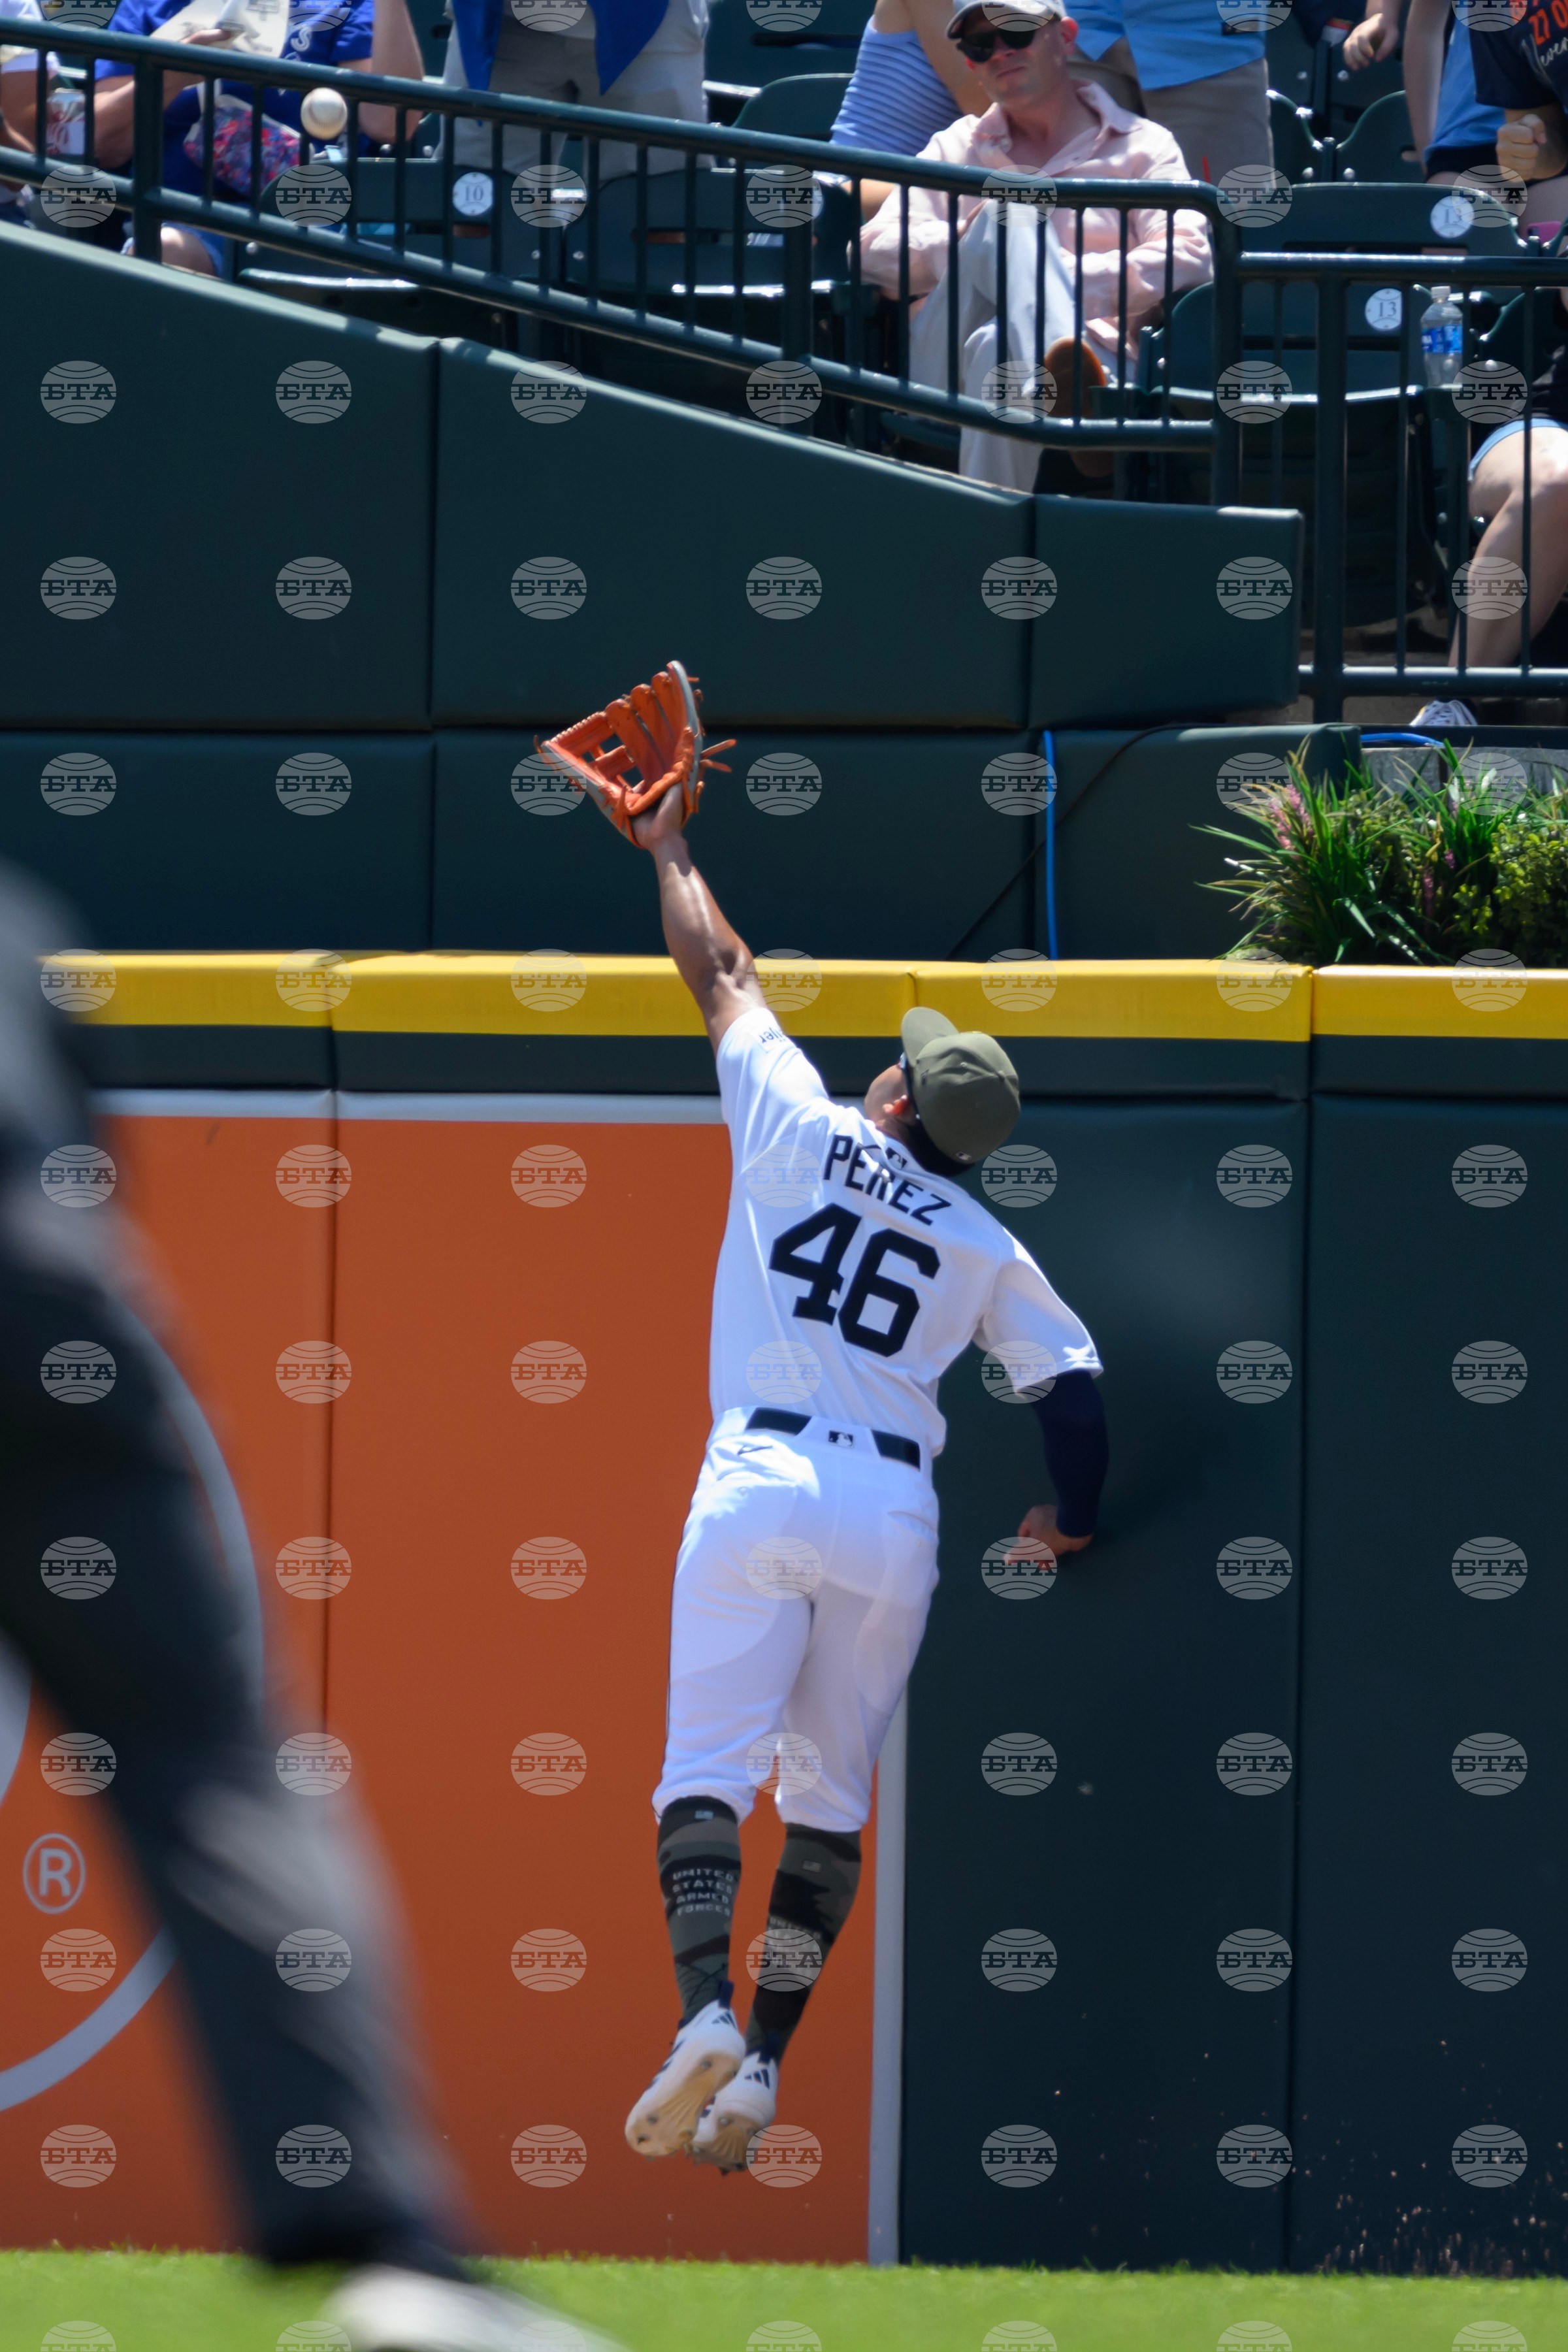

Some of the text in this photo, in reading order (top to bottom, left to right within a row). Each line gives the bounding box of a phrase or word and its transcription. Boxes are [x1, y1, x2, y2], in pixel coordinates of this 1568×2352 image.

[465, 185, 484, 201] 10
[1444, 208, 1462, 225] 13
[1378, 301, 1397, 318] 13
[823, 1135, 951, 1226] PEREZ
[769, 1203, 940, 1358] 46
[672, 1868, 734, 1882] UNITED
[672, 1880, 733, 1895] STATES
[676, 1892, 729, 1904] ARMED
[676, 1903, 731, 1917] FORCES
